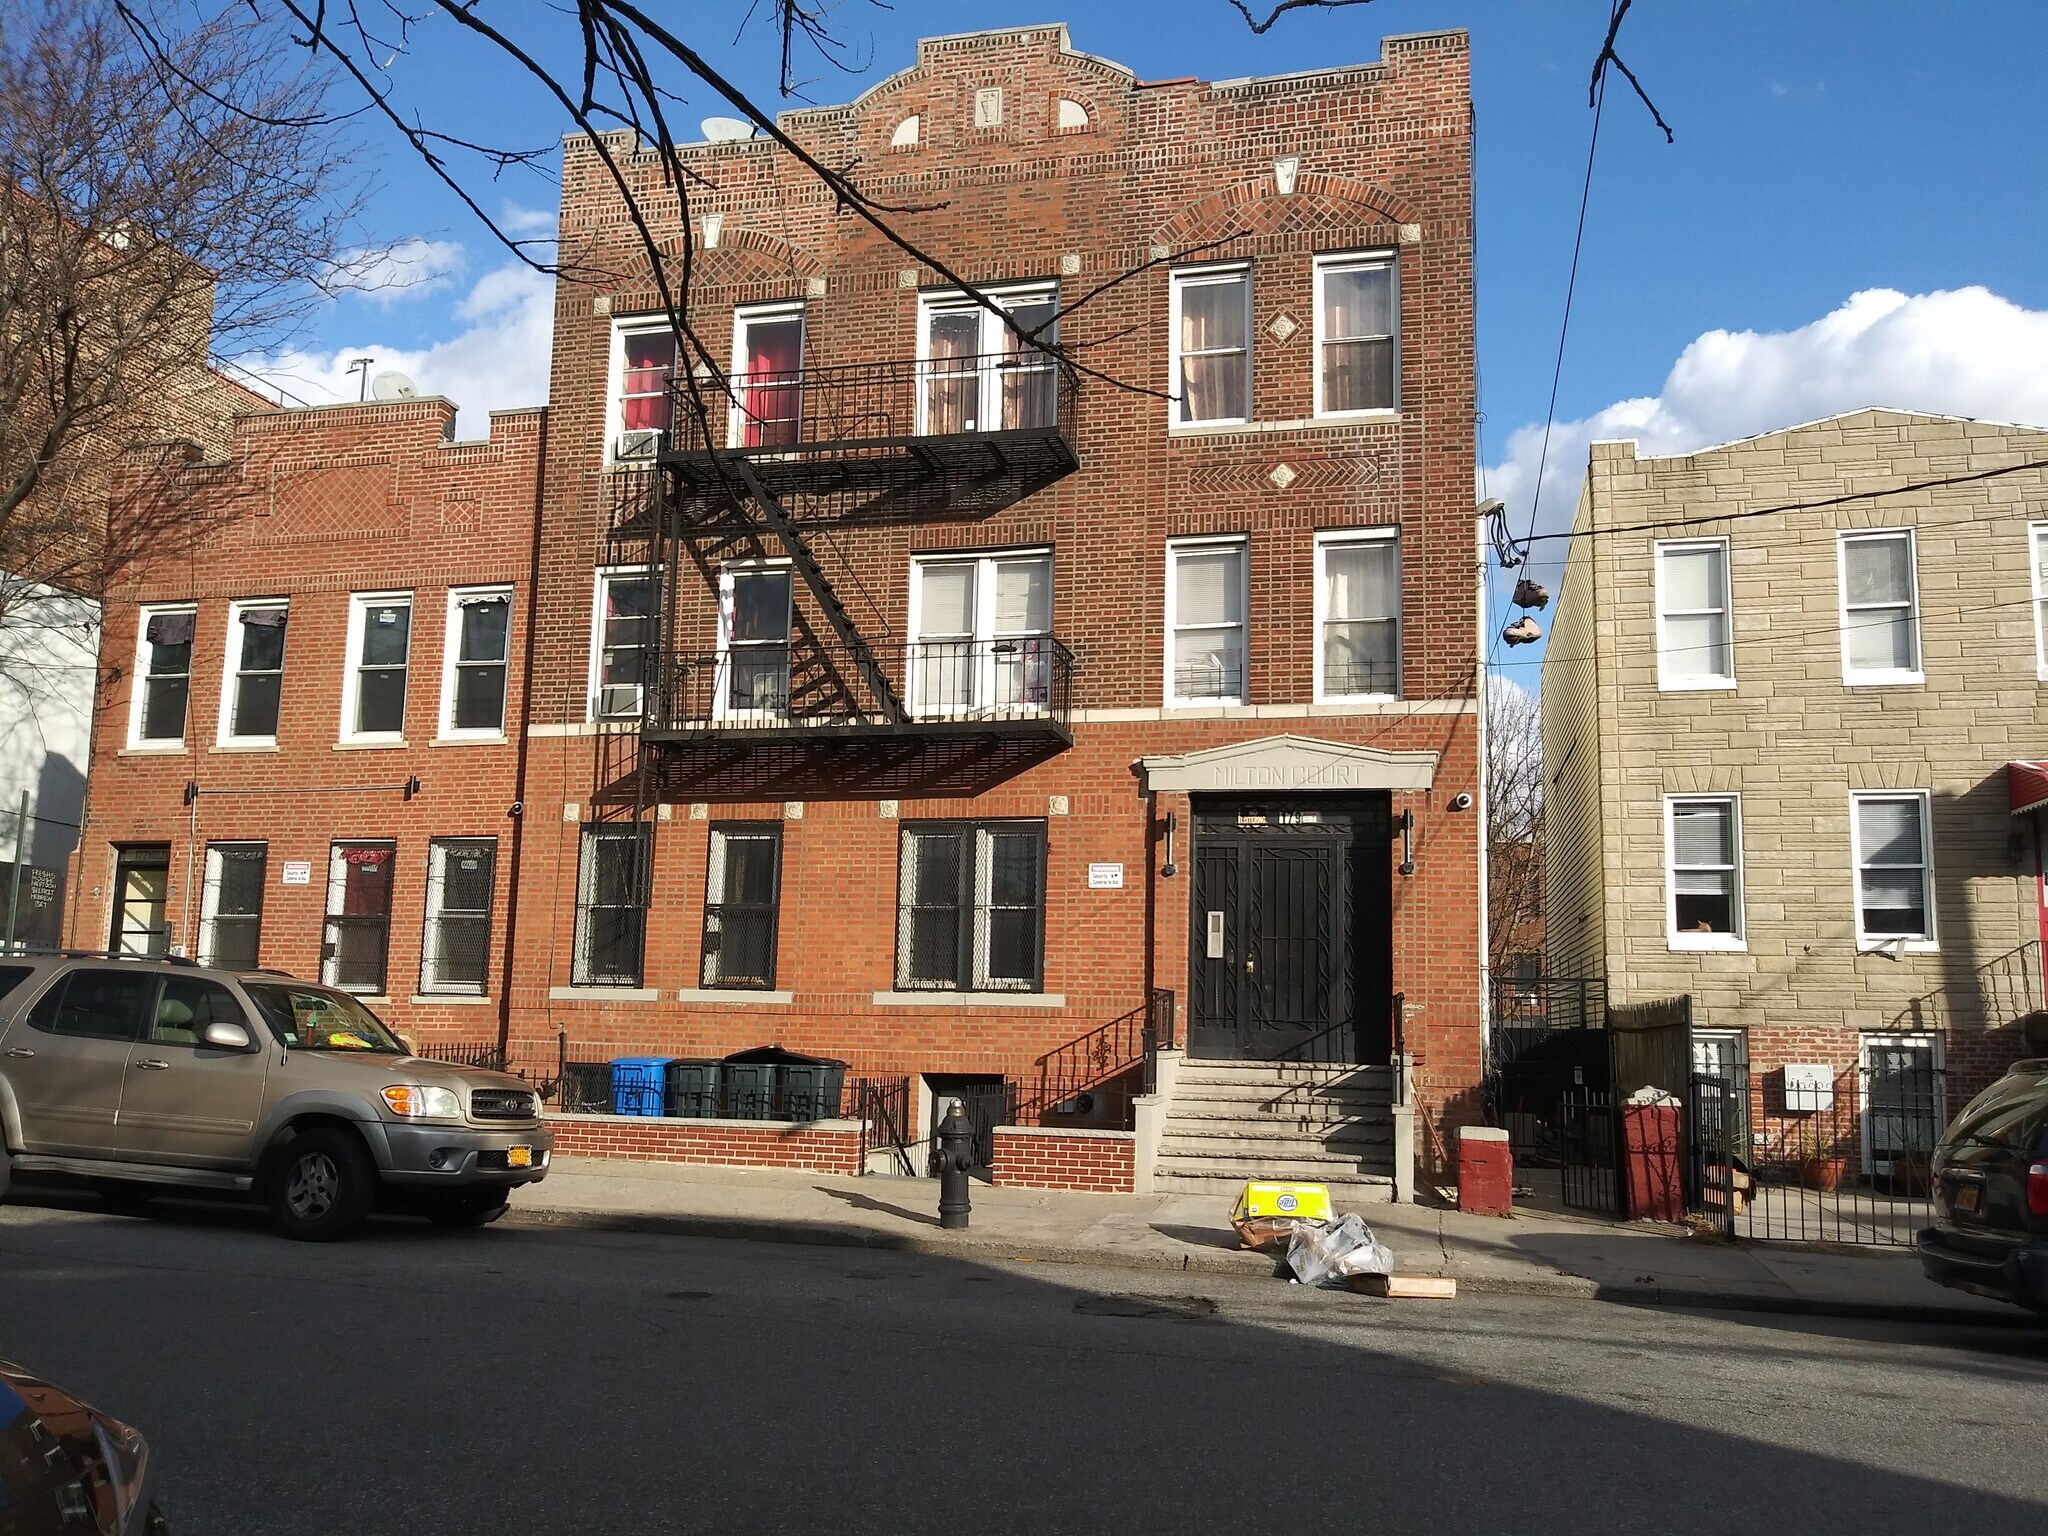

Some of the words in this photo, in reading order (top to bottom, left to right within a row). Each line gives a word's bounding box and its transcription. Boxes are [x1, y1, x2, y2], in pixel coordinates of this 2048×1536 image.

[1213, 766, 1285, 786] MILTON
[1291, 765, 1365, 785] COURT
[1279, 1197, 1296, 1208] Tide
